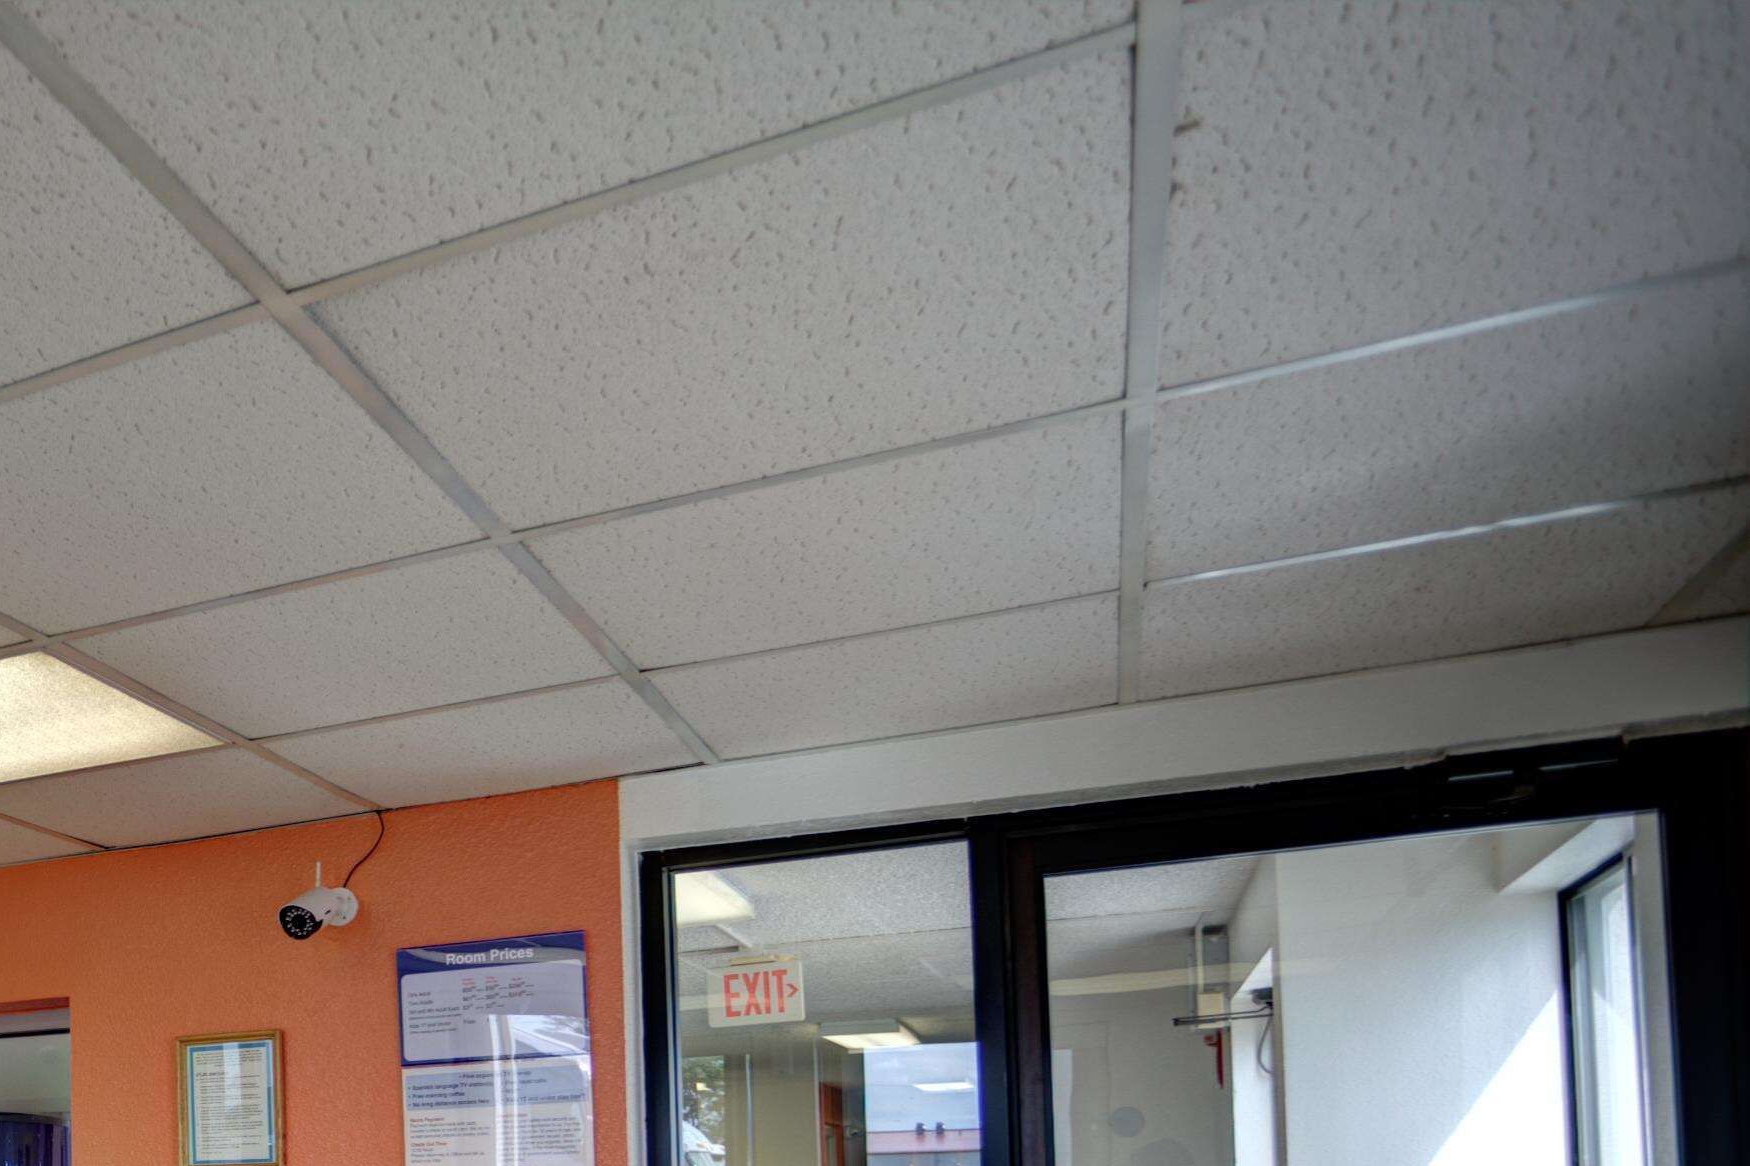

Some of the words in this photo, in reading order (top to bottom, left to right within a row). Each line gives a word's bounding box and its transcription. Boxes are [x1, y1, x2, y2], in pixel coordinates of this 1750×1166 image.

[445, 952, 486, 966] Room
[489, 947, 535, 962] Prices
[723, 968, 788, 1018] EXIT
